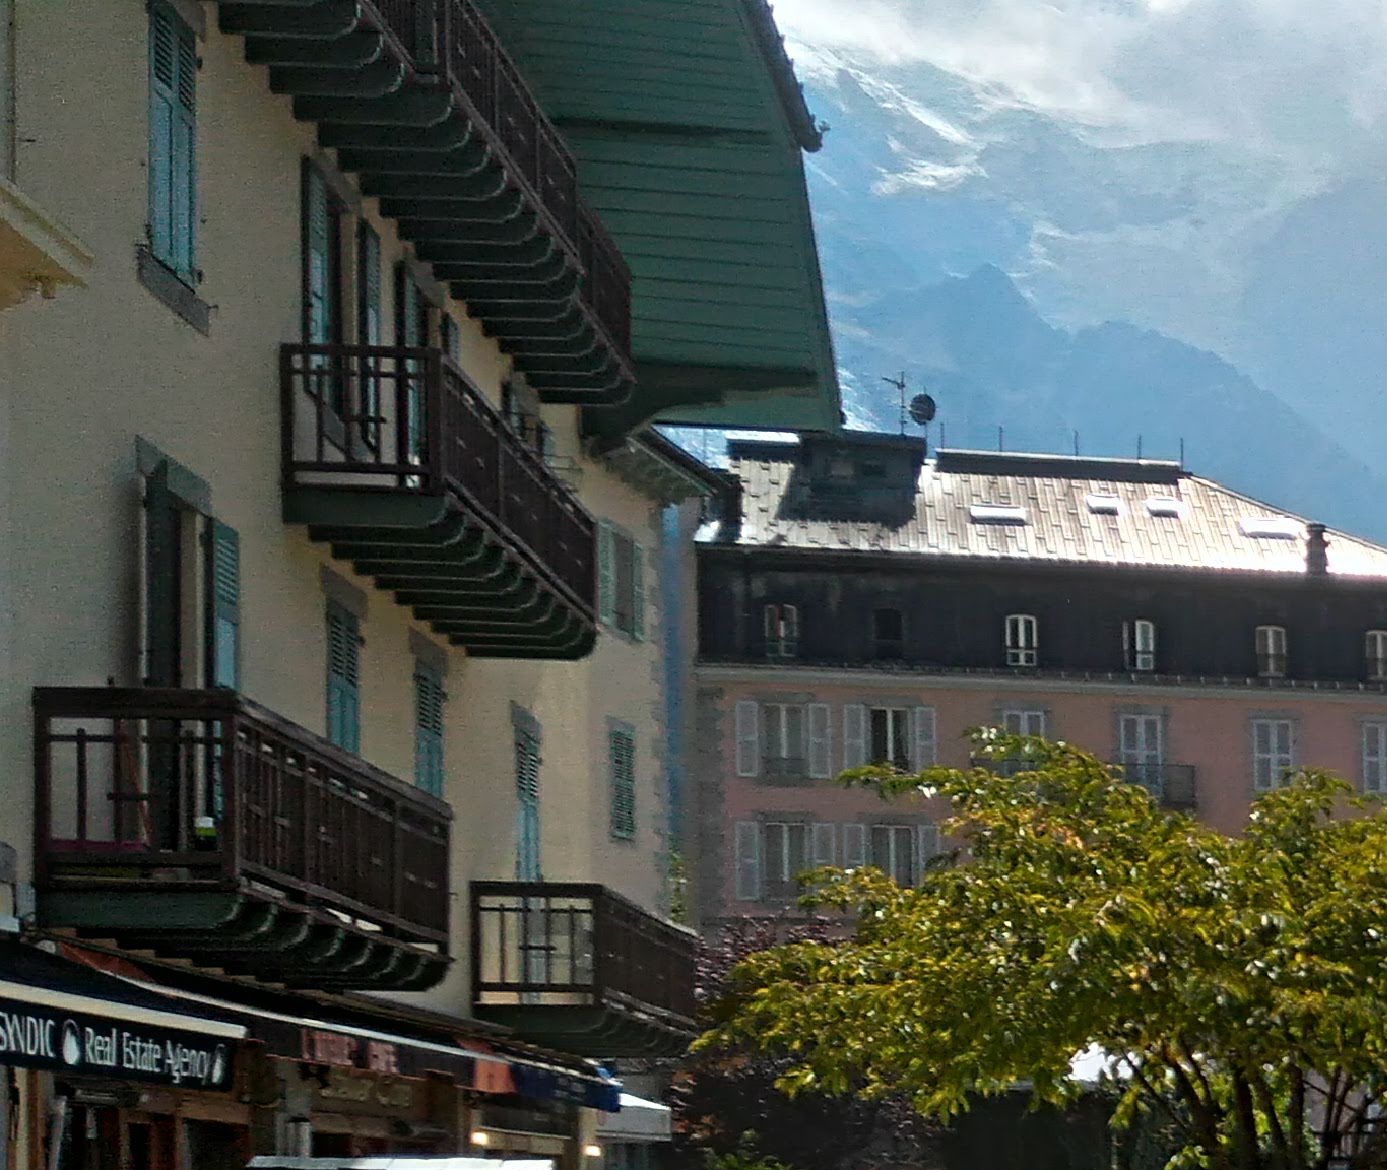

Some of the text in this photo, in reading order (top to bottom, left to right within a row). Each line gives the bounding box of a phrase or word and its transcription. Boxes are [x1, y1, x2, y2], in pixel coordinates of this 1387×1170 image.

[85, 1027, 117, 1066] Real
[123, 1032, 161, 1072] Estate
[164, 1040, 209, 1085] Agency
